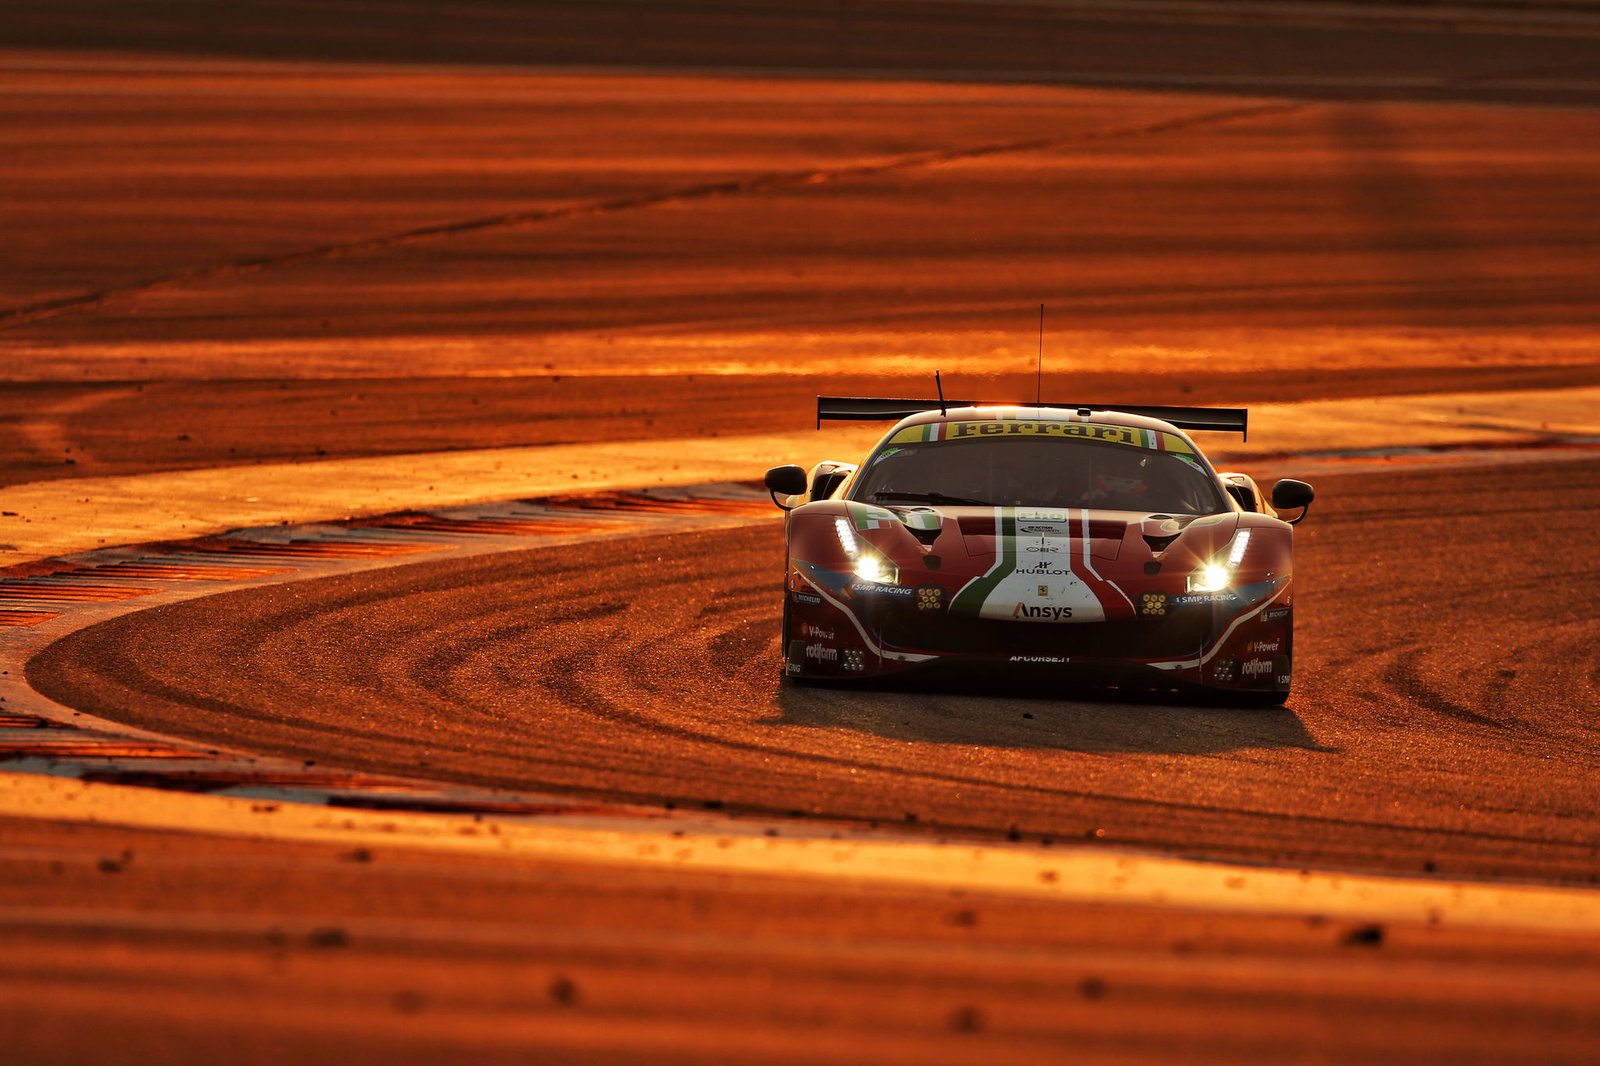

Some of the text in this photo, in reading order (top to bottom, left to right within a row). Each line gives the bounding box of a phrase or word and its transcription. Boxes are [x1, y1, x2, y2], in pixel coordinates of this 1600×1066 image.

[952, 421, 1135, 443] Ferrari
[855, 583, 912, 595] SMP RACING
[1203, 594, 1236, 602] RACING
[1012, 602, 1072, 620] Ansys
[808, 625, 835, 639] V-Power
[1254, 641, 1279, 652] V-Power
